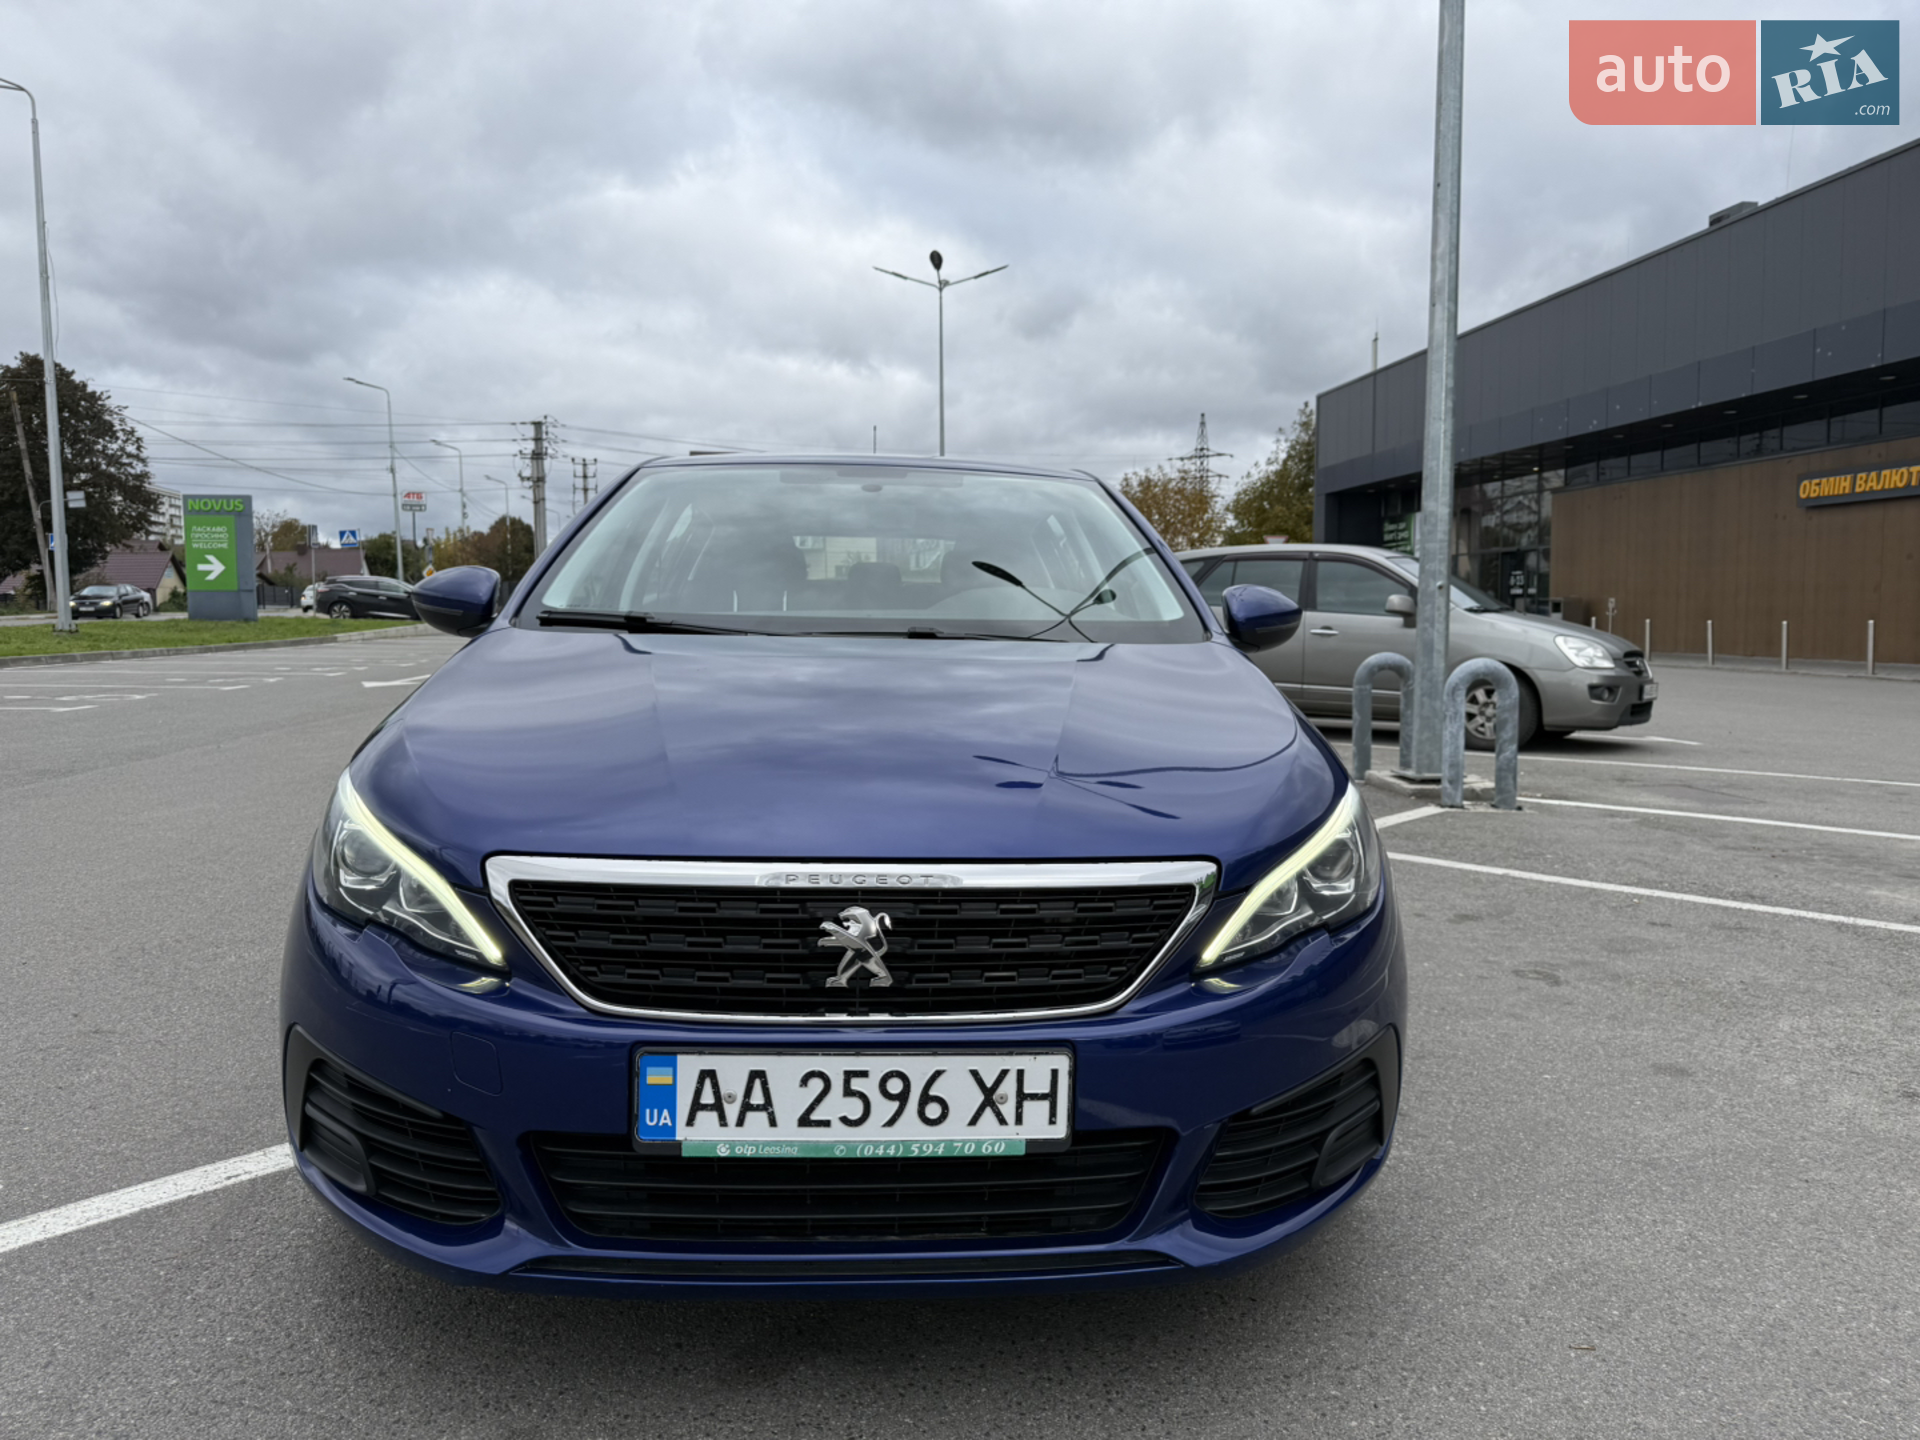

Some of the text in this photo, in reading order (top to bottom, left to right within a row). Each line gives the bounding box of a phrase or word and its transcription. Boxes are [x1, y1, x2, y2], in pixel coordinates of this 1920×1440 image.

[1799, 465, 1920, 499] ОБМІН ВАЛЮТ
[188, 498, 244, 512] NOVUS
[785, 874, 933, 885] PEUGEOT
[685, 1068, 1059, 1127] AA 2596 XH
[645, 1108, 672, 1126] UA
[735, 1145, 756, 1156] otp
[856, 1144, 903, 1157] (044)
[909, 1143, 945, 1156] 594
[953, 1142, 975, 1154] 70
[981, 1140, 1005, 1154] 60
